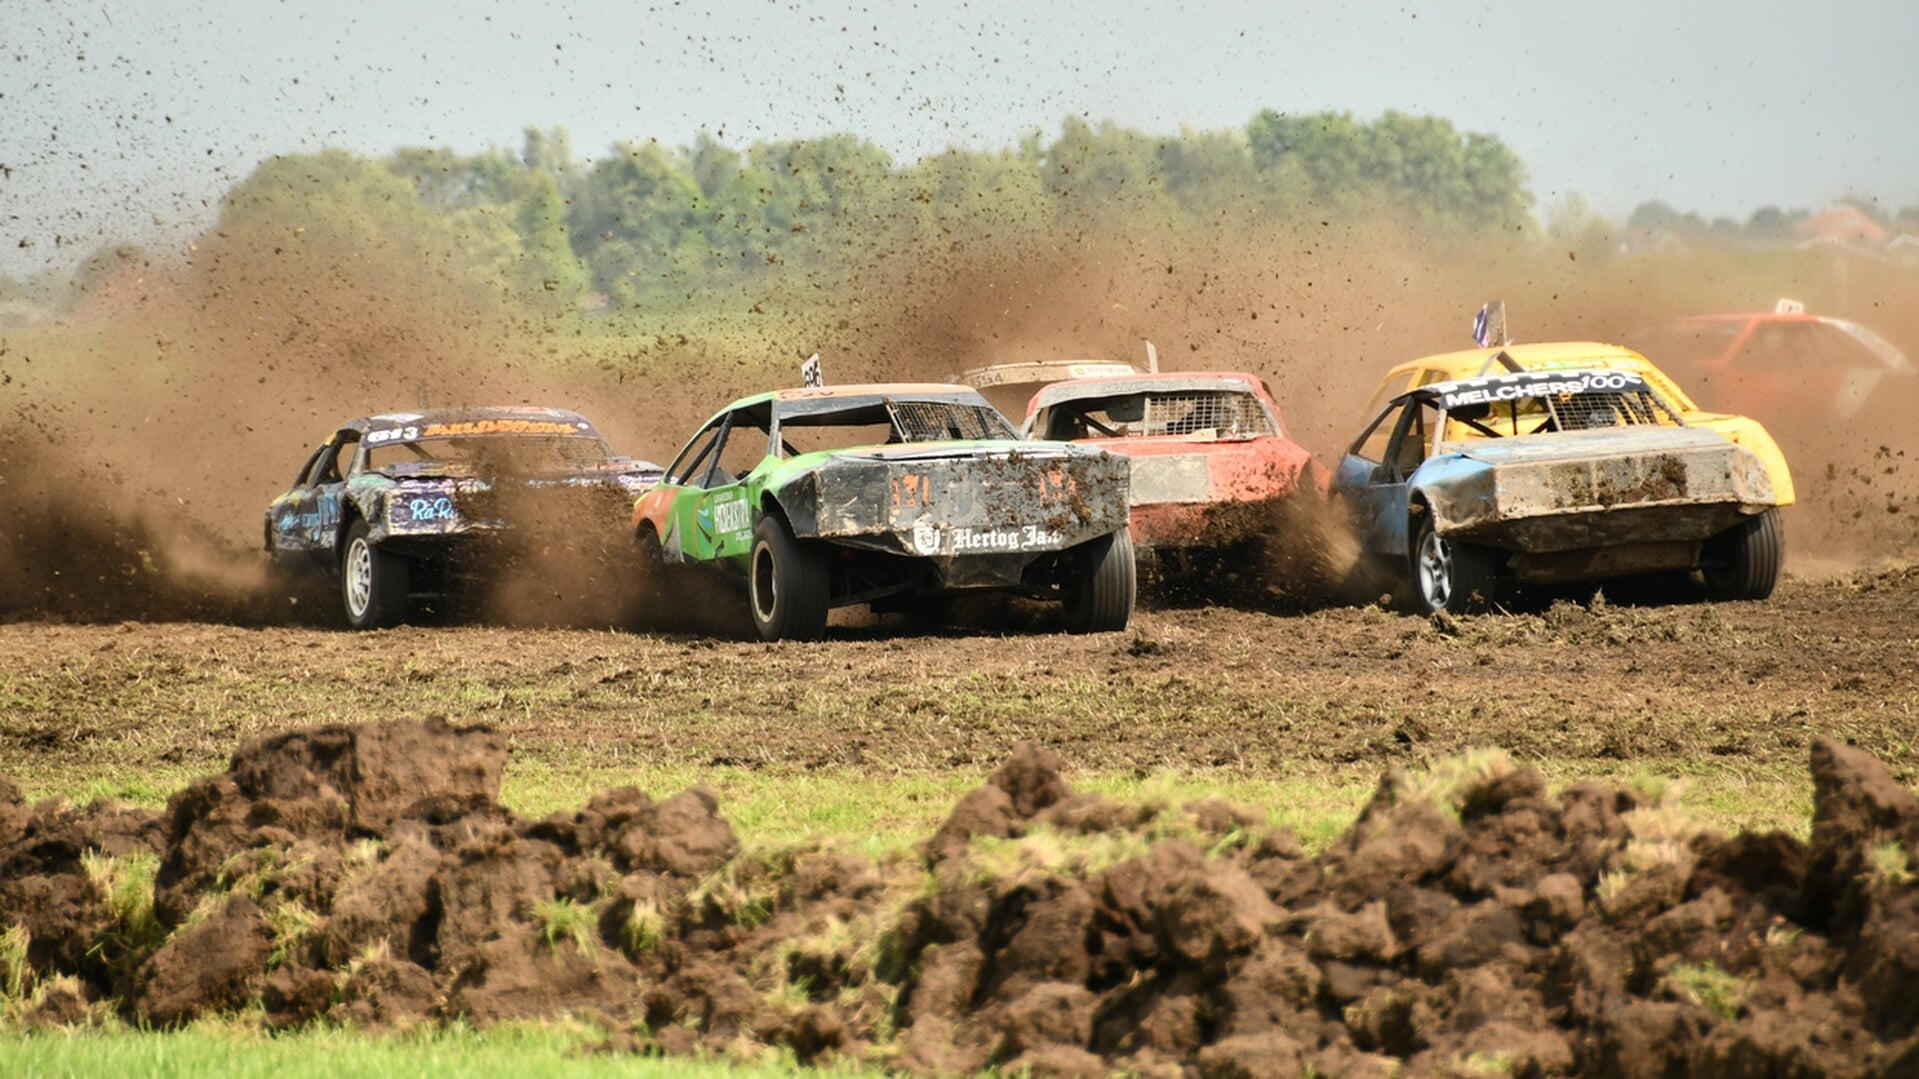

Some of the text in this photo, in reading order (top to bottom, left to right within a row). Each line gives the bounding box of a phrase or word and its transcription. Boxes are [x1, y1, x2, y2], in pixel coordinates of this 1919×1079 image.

[1446, 376, 1626, 406] MELCHERS 100
[952, 528, 1019, 551] Hertog
